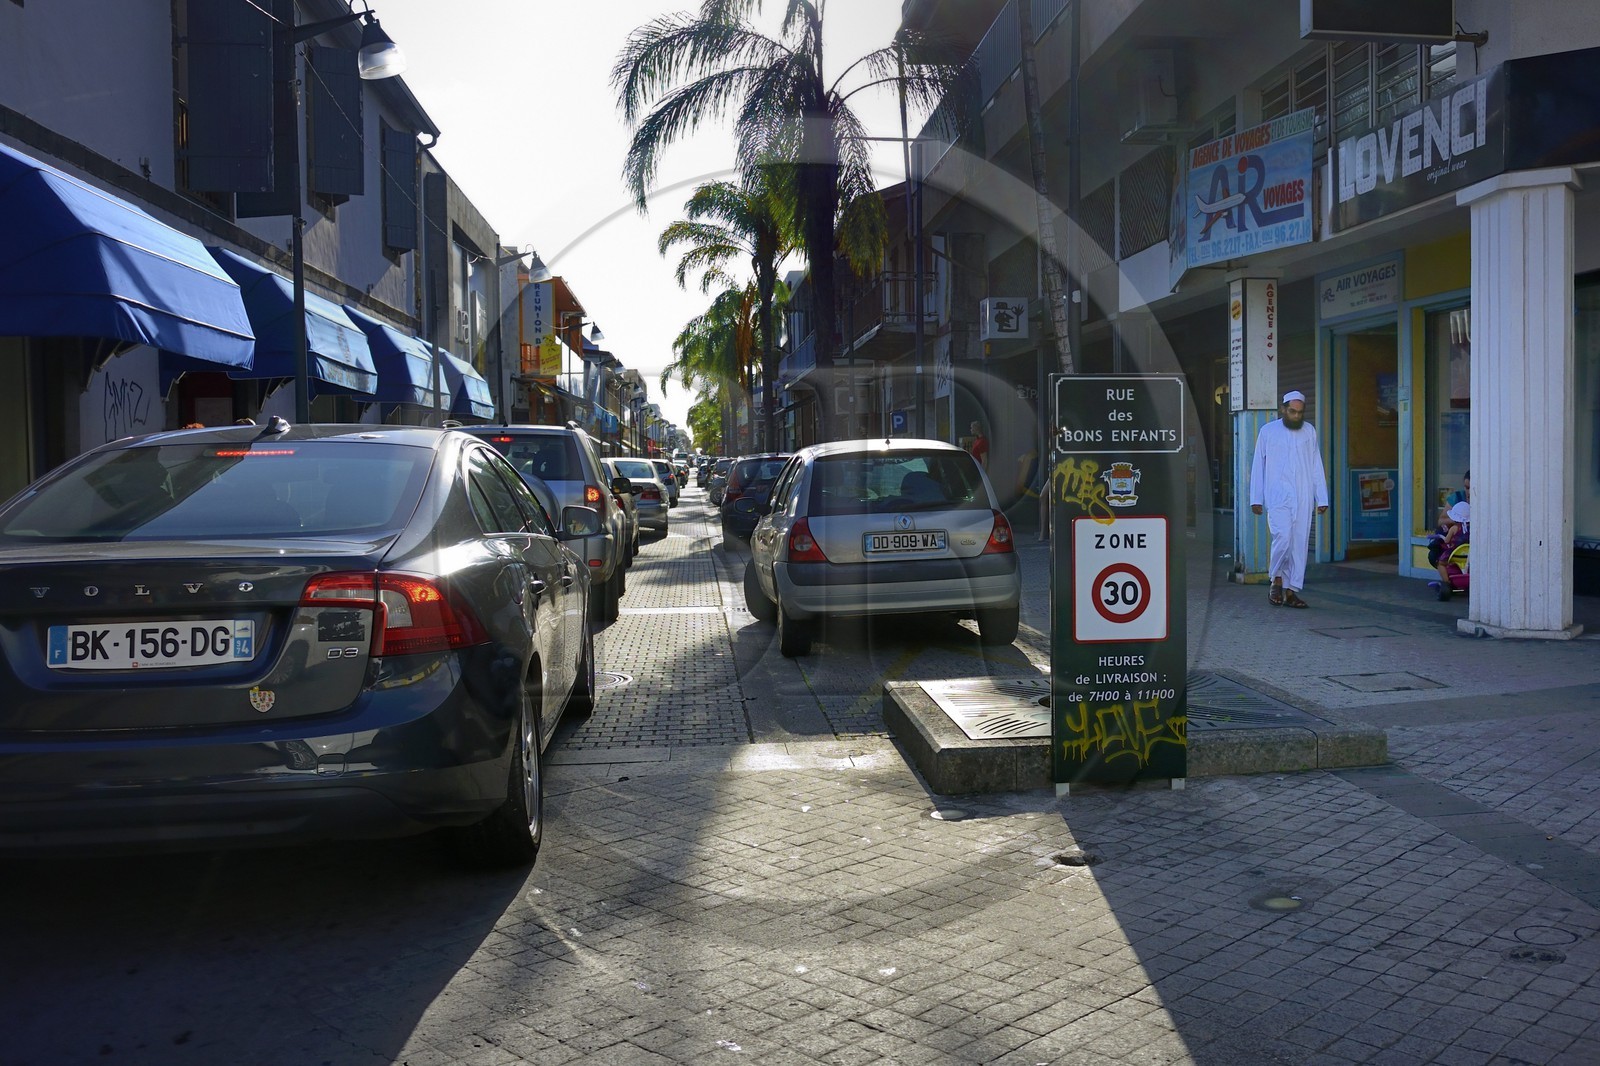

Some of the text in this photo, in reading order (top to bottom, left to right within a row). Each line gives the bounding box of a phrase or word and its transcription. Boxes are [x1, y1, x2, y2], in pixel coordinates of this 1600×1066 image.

[1192, 141, 1220, 168] AGENCE
[1222, 138, 1232, 158] DE
[1235, 123, 1271, 154] VOYAGES
[1338, 78, 1486, 203] LOVENCI
[1427, 152, 1466, 184] original wear
[1263, 179, 1304, 210] VOYAGES
[1336, 277, 1351, 292] AIR
[1353, 264, 1396, 287] VOYAGES
[1106, 389, 1134, 400] RUE
[894, 415, 904, 428] P
[1108, 410, 1133, 421] des
[1065, 430, 1176, 442] BONS ENFANTS
[1095, 534, 1147, 548] ZONE
[30, 581, 254, 598] VOLVO
[1104, 580, 1138, 605] 30
[71, 626, 230, 660] BK-156-DG
[55, 650, 61, 660] F
[328, 647, 359, 659] D3
[1098, 656, 1144, 667] HEURES
[1075, 674, 1090, 685] de
[1096, 673, 1157, 684] LIVRAISON
[1068, 689, 1175, 702] de 7H00 à 11H00
